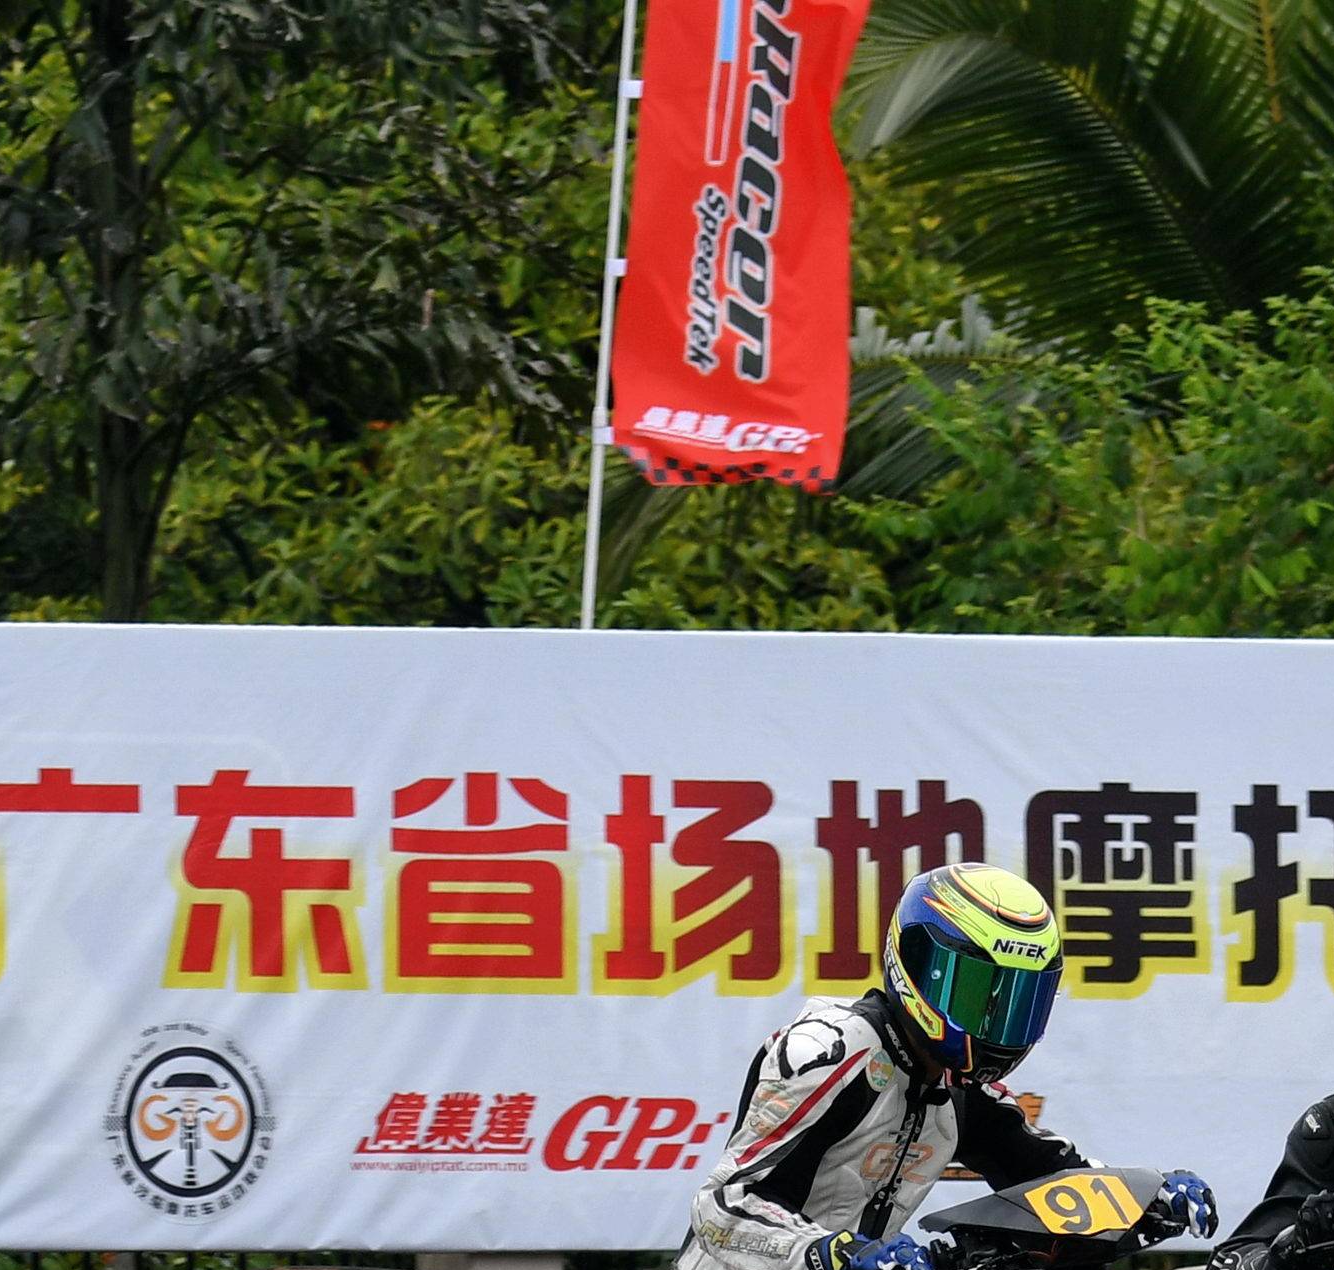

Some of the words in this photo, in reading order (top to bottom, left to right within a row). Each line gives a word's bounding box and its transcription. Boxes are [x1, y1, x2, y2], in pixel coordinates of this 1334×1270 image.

[727, 0, 800, 382] Racer
[685, 184, 728, 374] SpeedTek
[370, 1091, 538, 1150] 偉業達
[1044, 1177, 1131, 1233] 91
